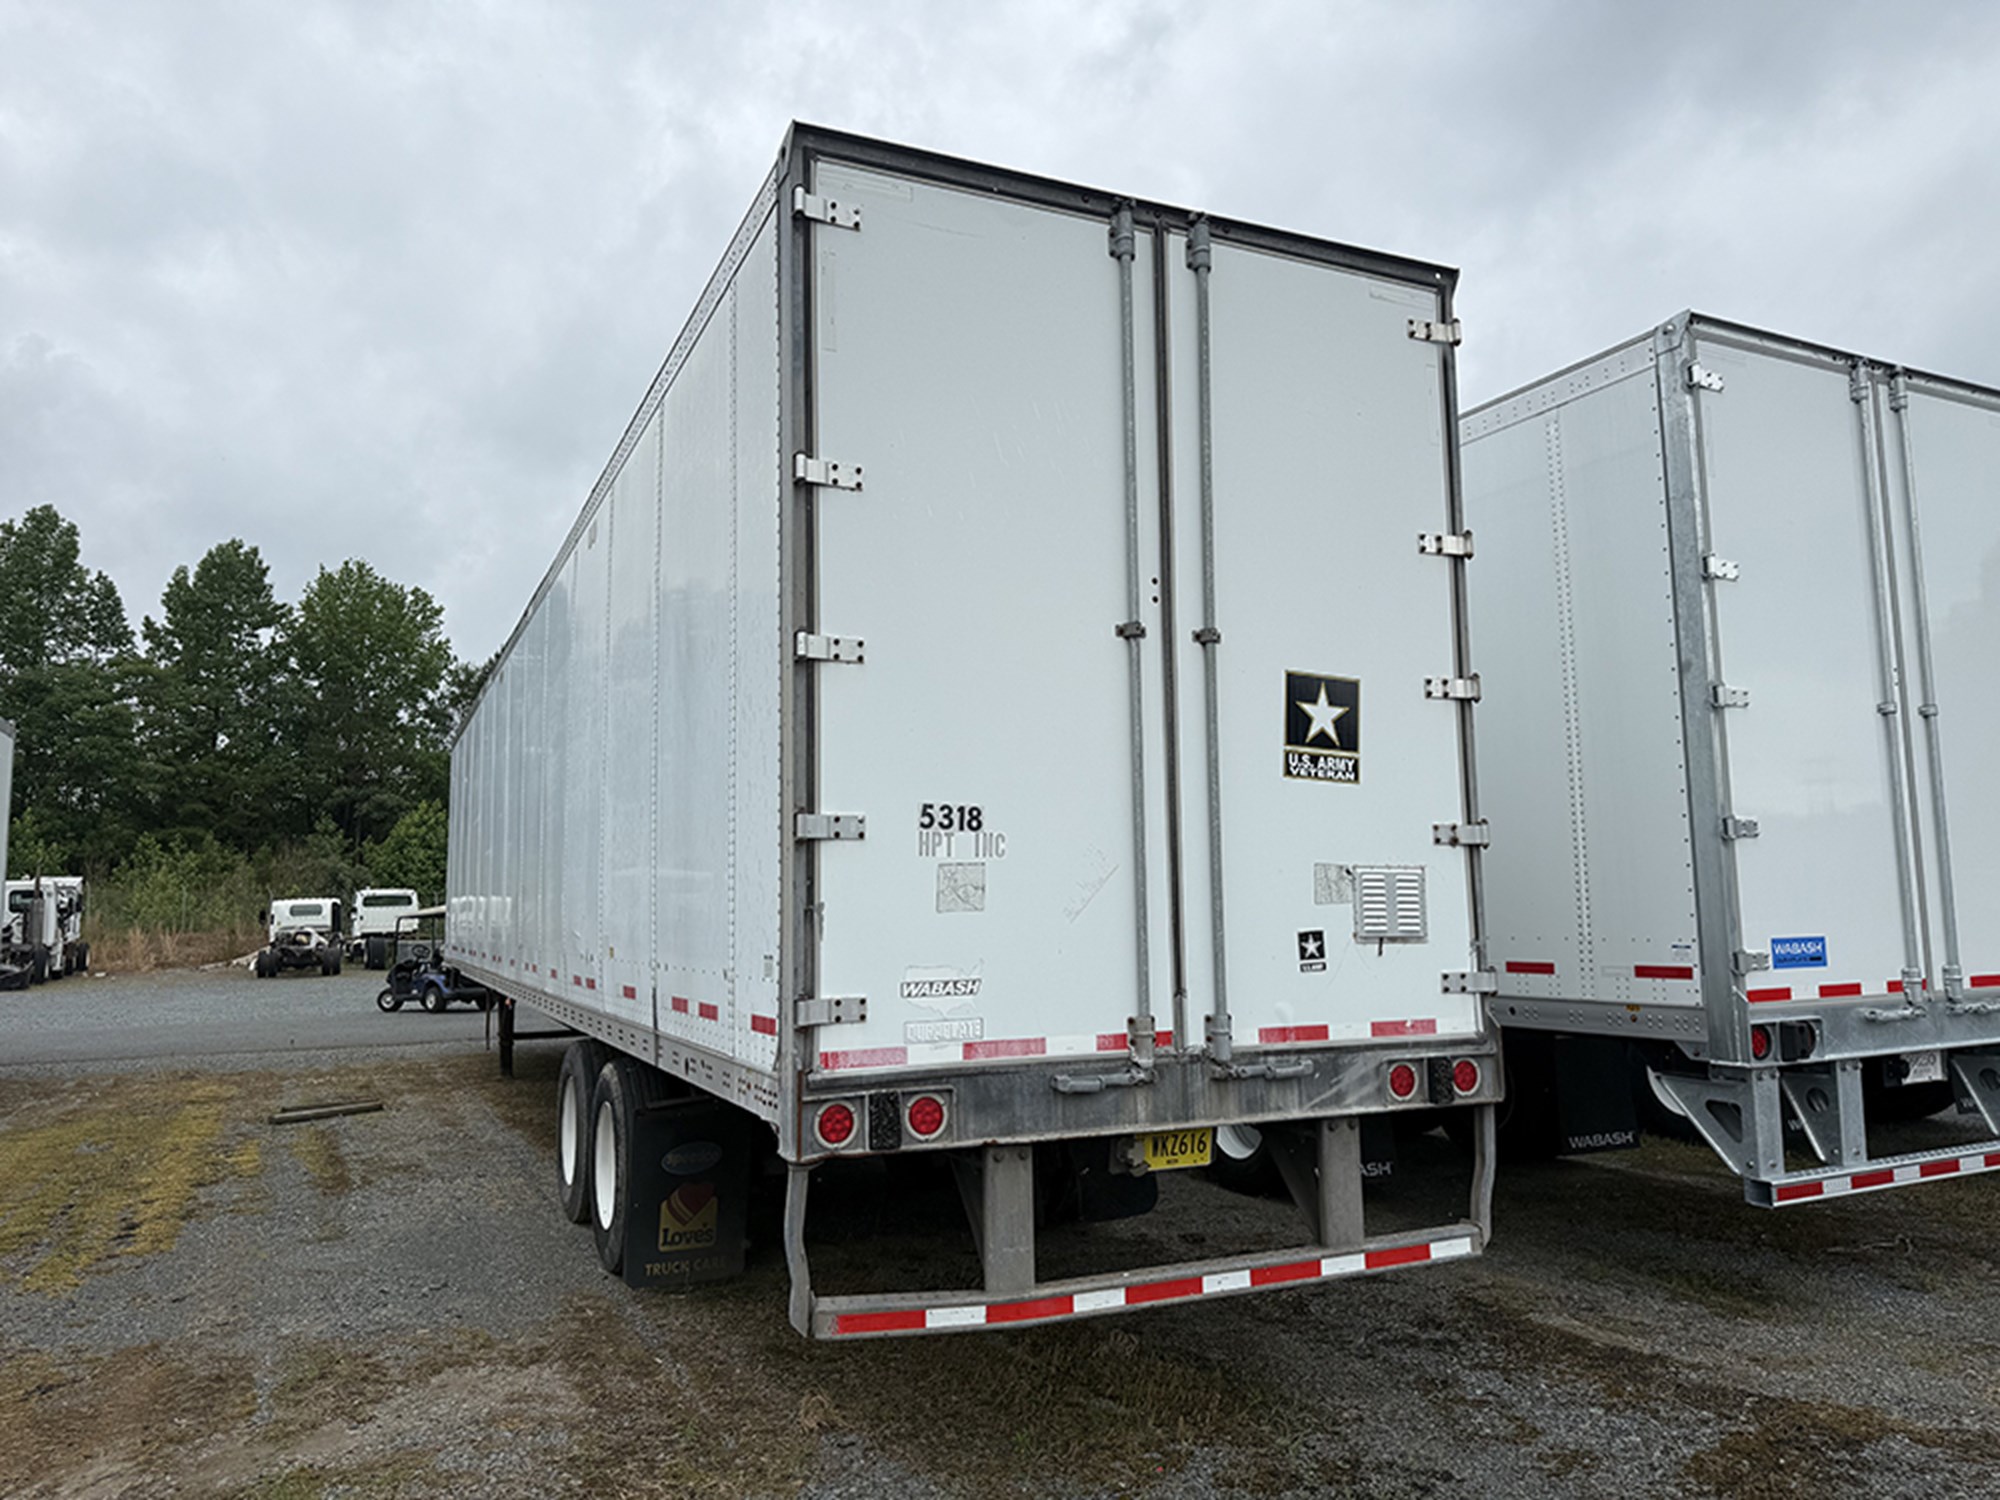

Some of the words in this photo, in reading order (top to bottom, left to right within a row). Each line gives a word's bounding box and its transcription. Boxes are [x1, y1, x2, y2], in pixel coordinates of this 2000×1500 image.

[1288, 752, 1314, 768] U.S.
[1318, 756, 1355, 773] ARMY
[1289, 766, 1355, 780] VETERAN
[919, 803, 983, 832] 5318
[918, 830, 954, 857] HPT
[1773, 941, 1823, 955] WABASH
[902, 979, 981, 998] WABASH
[1568, 1131, 1635, 1149] WABASH
[1359, 1161, 1392, 1177] ASH
[645, 1259, 690, 1277] TRUCK
